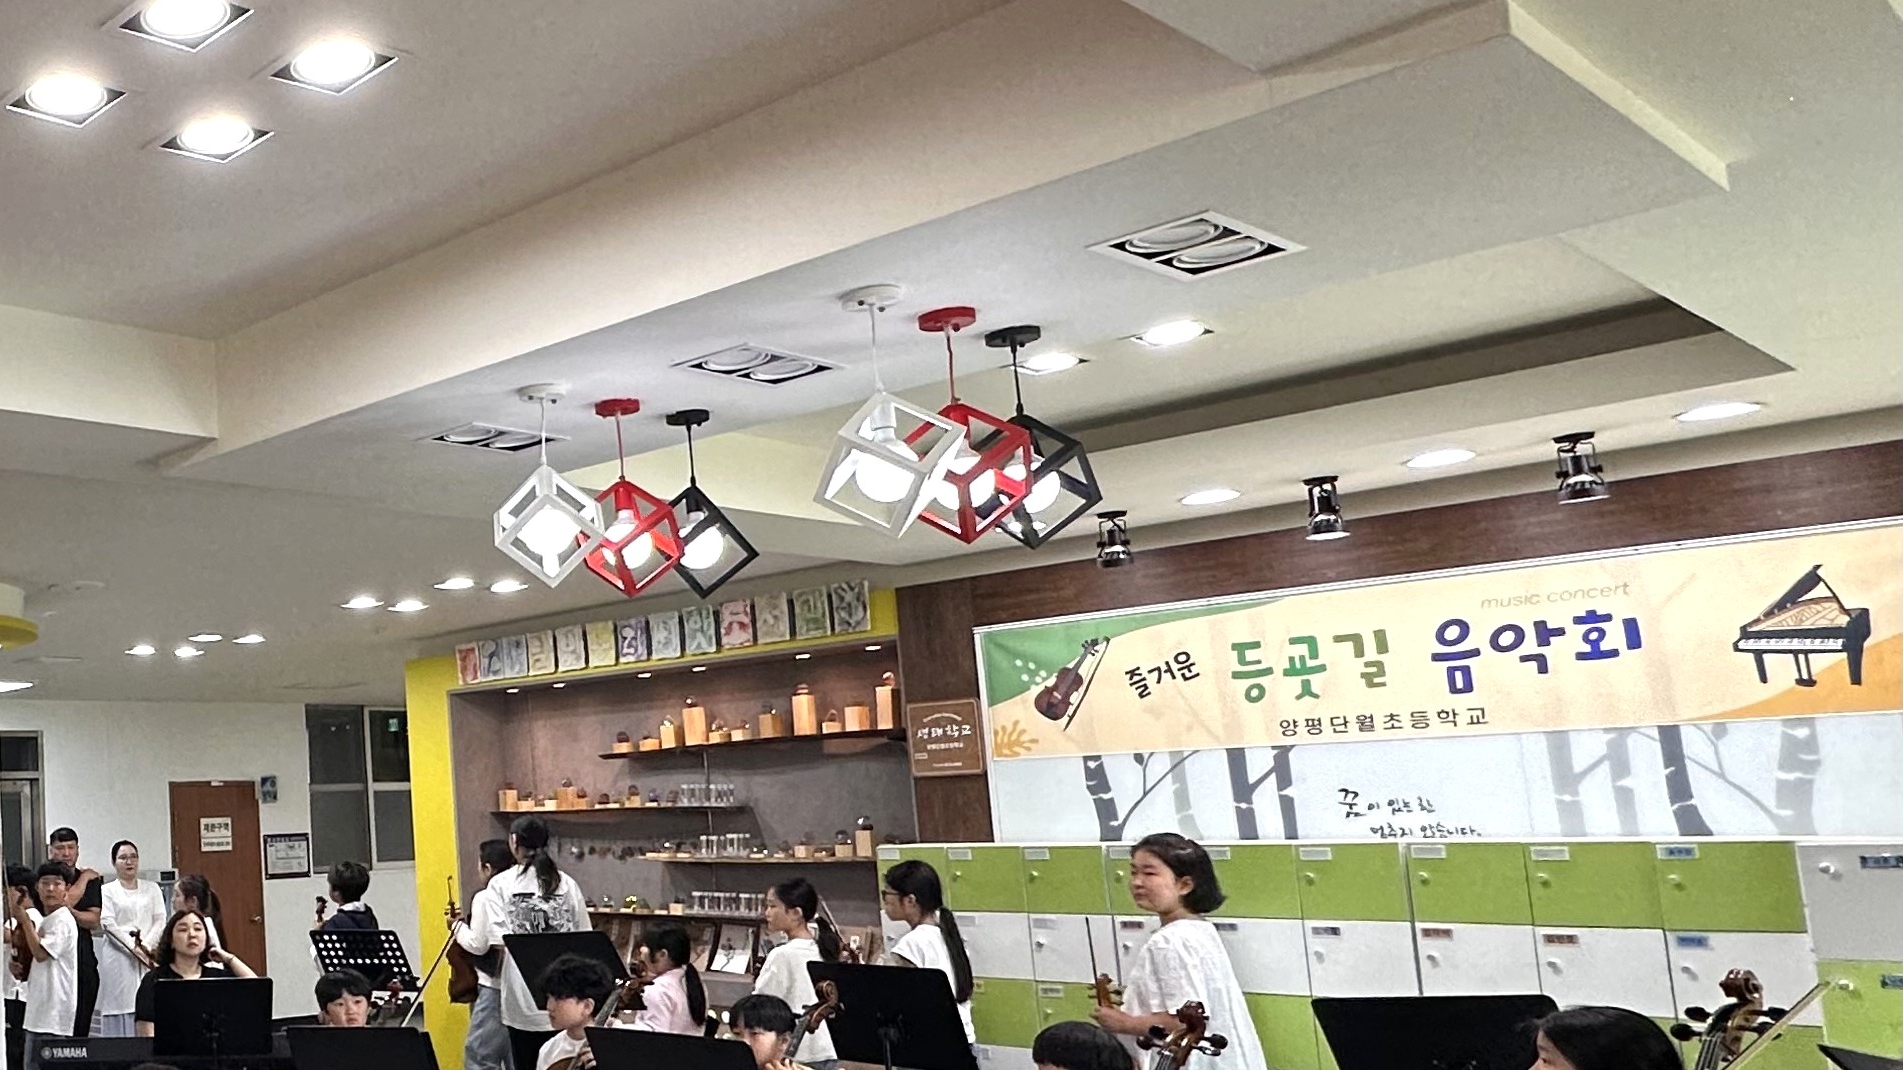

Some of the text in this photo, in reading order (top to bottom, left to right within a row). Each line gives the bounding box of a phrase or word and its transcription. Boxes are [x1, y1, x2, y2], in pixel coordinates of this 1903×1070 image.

[1480, 580, 1631, 611] music concert
[1124, 609, 1643, 705] 즐거운 등굣길 음악회
[1278, 706, 1489, 738] 양평단월초등학교
[1387, 797, 1413, 815] 있는
[52, 1047, 87, 1058] YAMAHA
